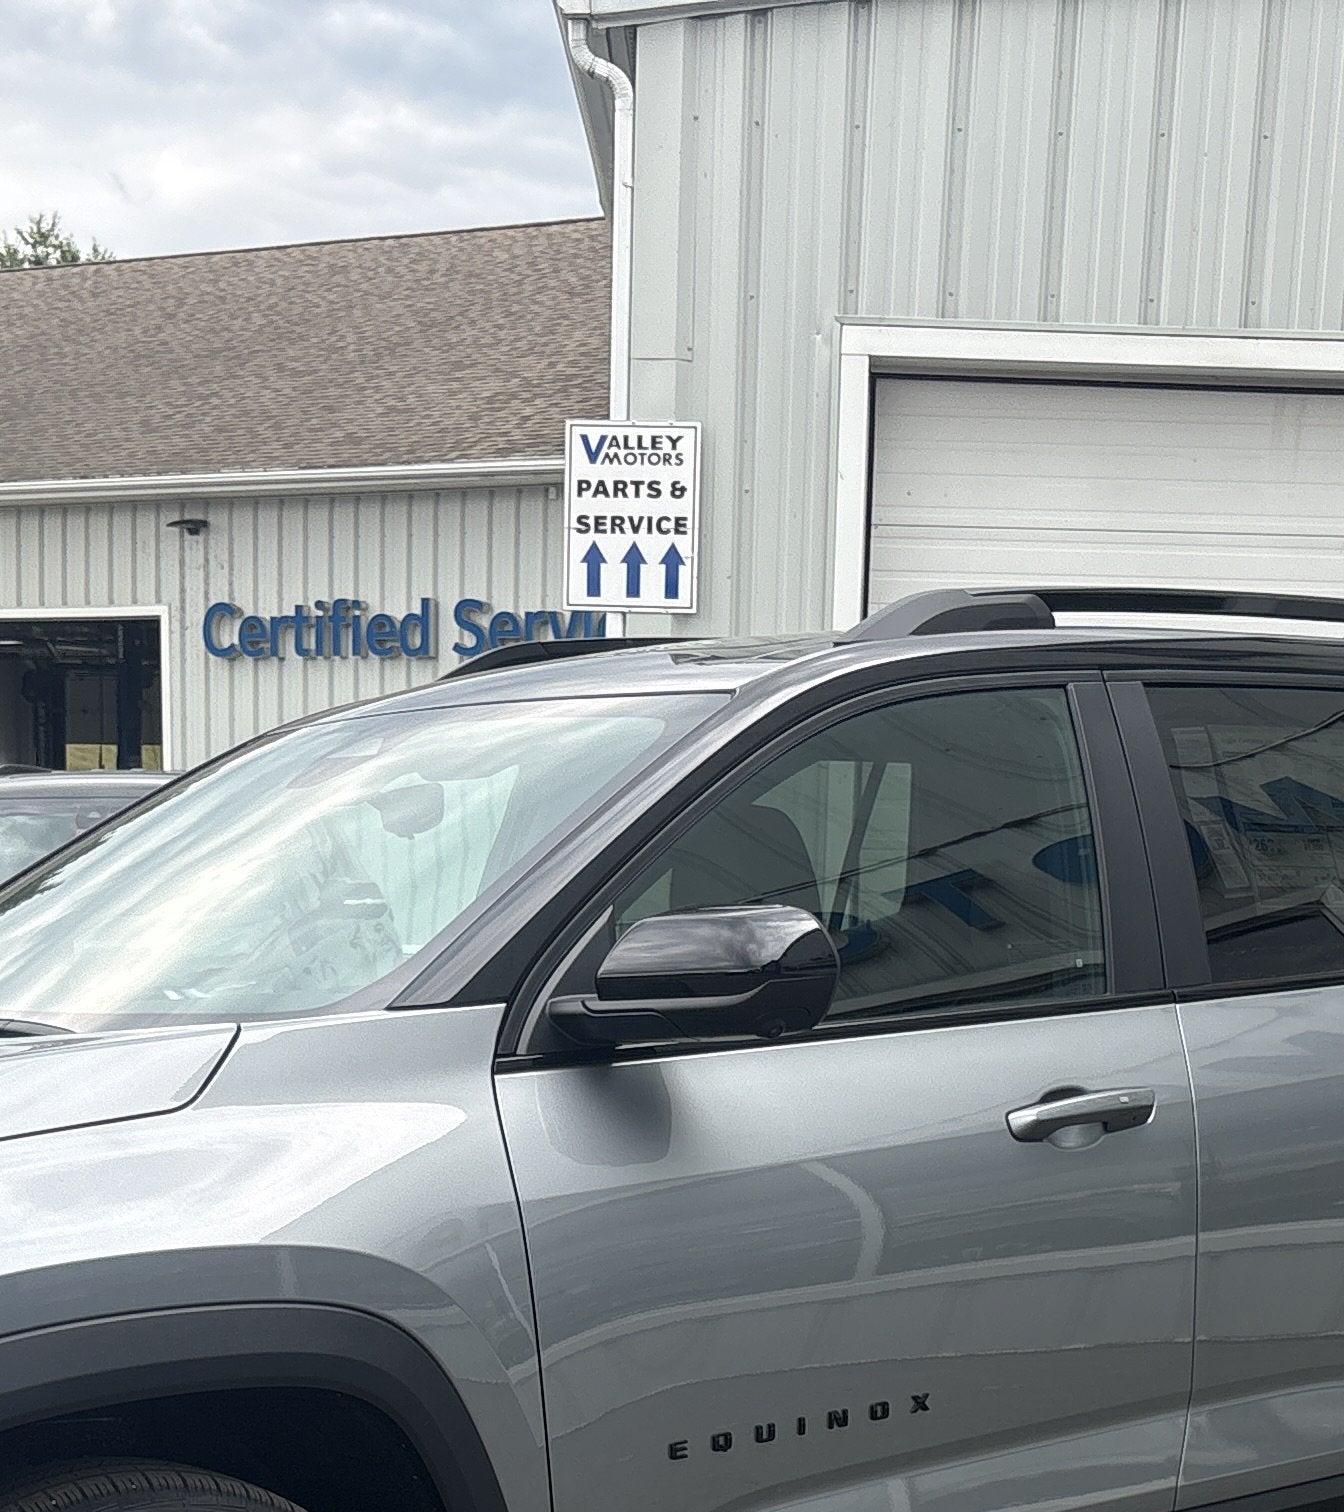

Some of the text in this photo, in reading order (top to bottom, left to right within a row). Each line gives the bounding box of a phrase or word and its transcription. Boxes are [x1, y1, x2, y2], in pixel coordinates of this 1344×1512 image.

[579, 434, 684, 465] VALLEY
[600, 452, 684, 466] MOTORS
[576, 480, 688, 499] PARTS &
[575, 515, 688, 535] SERVICE
[203, 598, 607, 659] Certified Servi
[668, 1393, 931, 1460] EQUINOX
